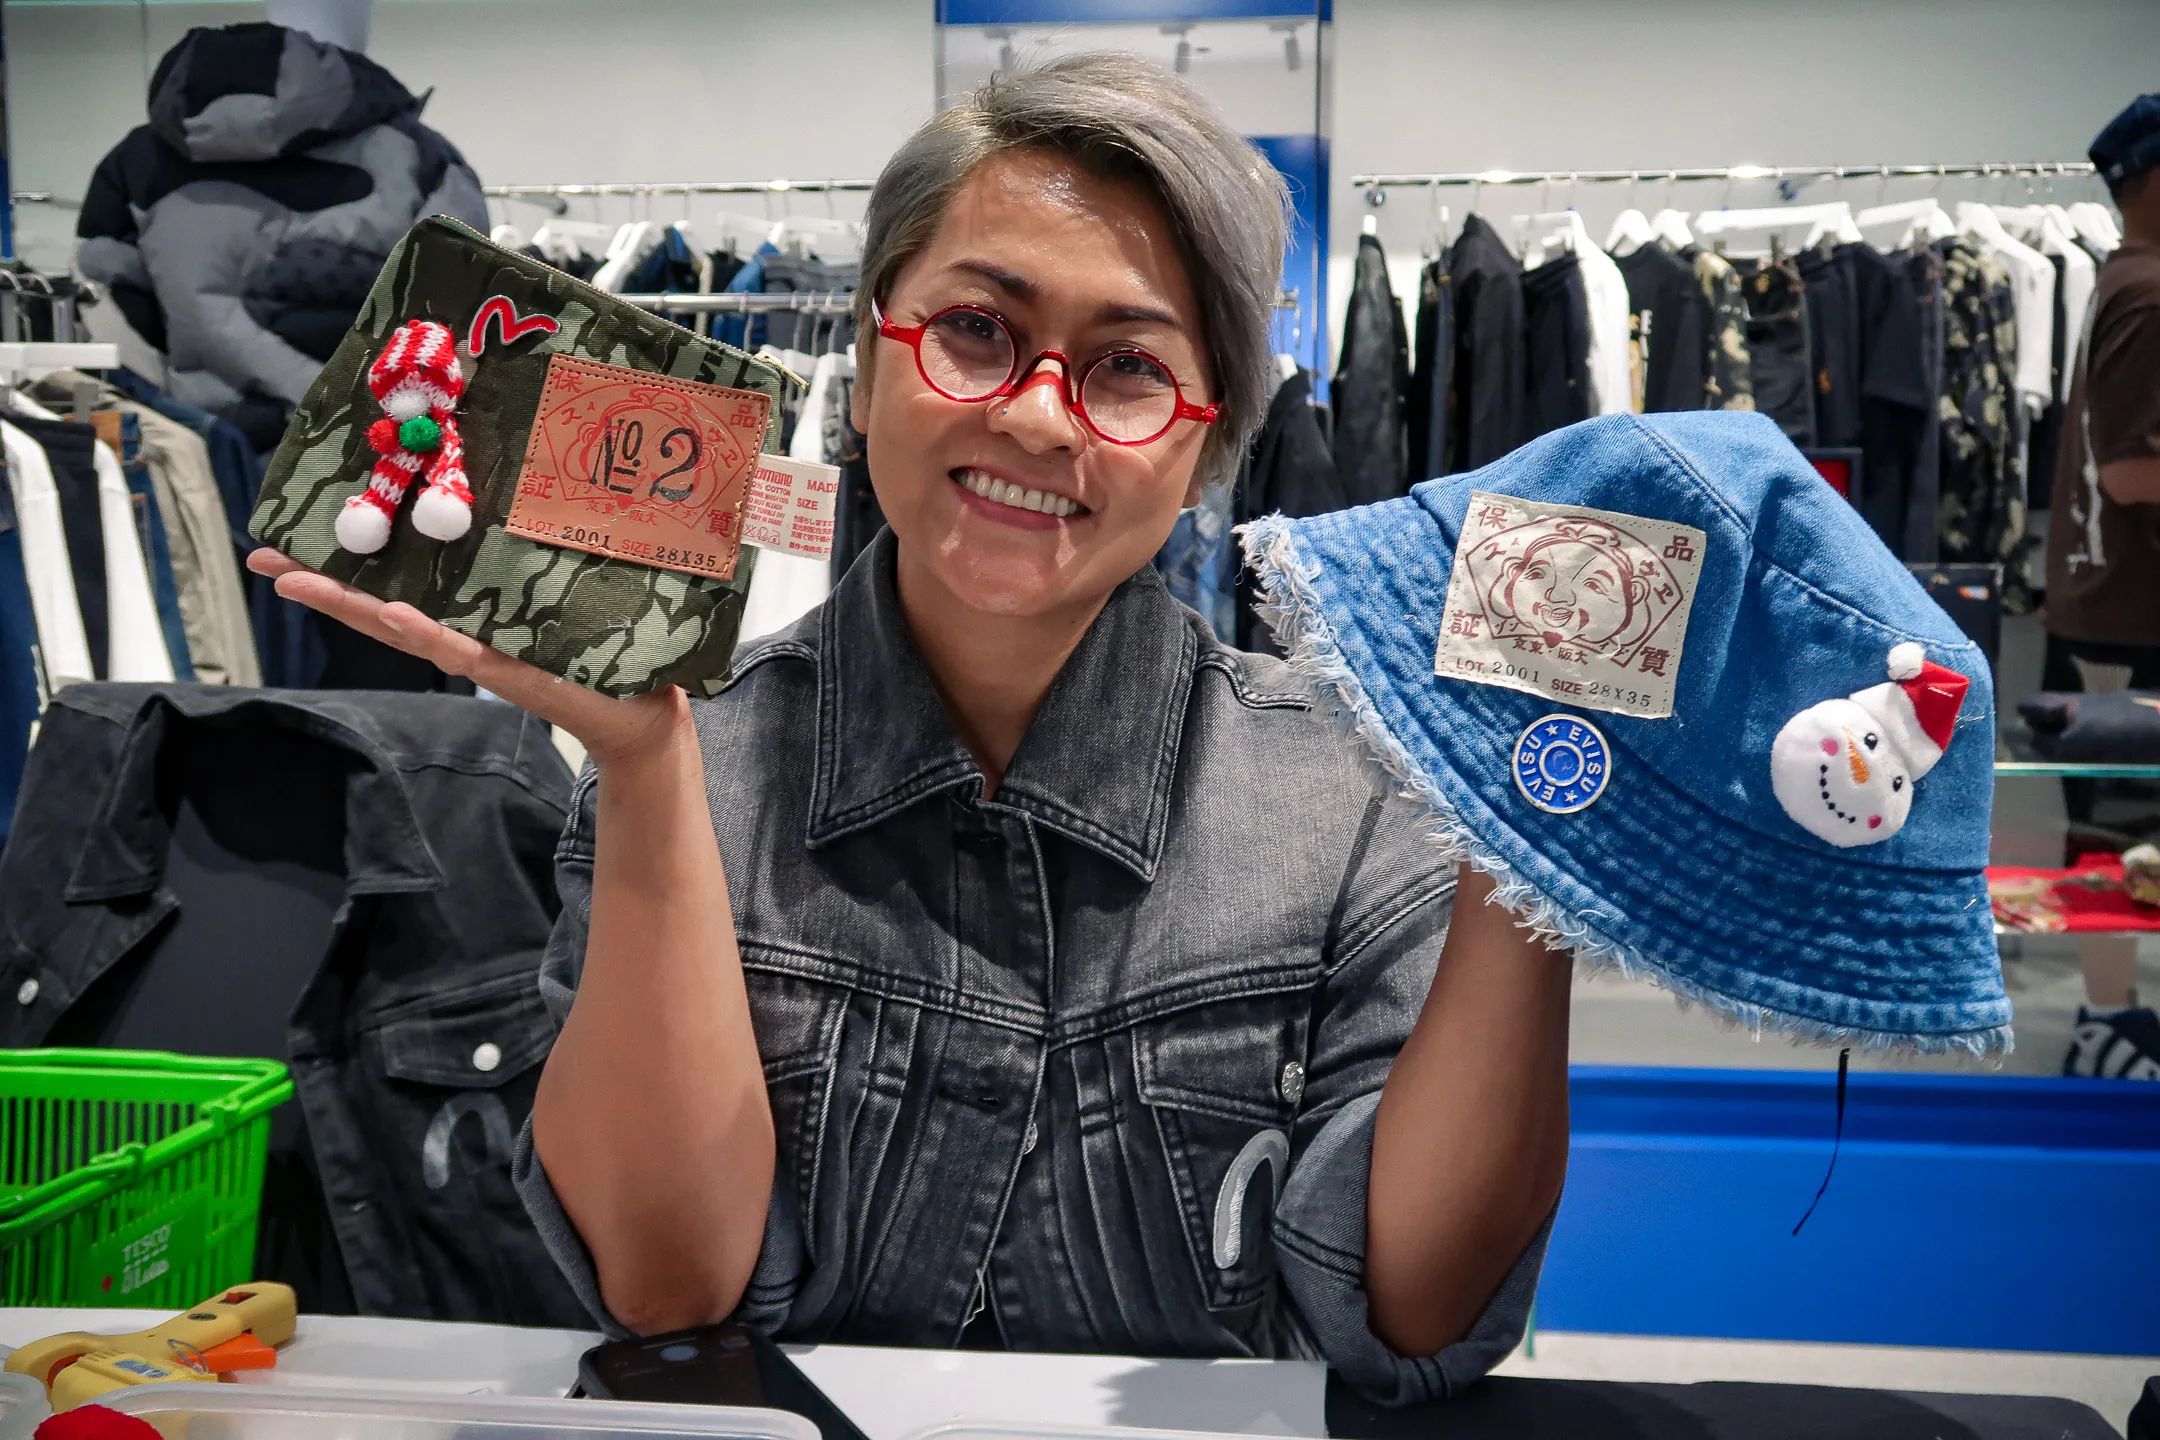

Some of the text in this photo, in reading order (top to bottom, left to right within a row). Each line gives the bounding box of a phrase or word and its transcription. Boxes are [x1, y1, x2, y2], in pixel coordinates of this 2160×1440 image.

[553, 369, 584, 393] 保
[729, 404, 757, 429] 品
[523, 471, 557, 500] 証
[765, 485, 791, 496] COTTON
[797, 497, 819, 510] SIZE
[1478, 506, 1508, 530] 保
[561, 525, 610, 550] 2001
[621, 539, 652, 555] SIZE
[655, 545, 717, 568] 28X35
[1662, 535, 1695, 563] 品
[1450, 609, 1484, 638] 証
[1492, 661, 1540, 684] 2001
[1551, 678, 1583, 696] SIZE
[1588, 681, 1652, 708] 28X35
[1520, 733, 1556, 802] EVISU
[1568, 724, 1603, 793] EVISU
